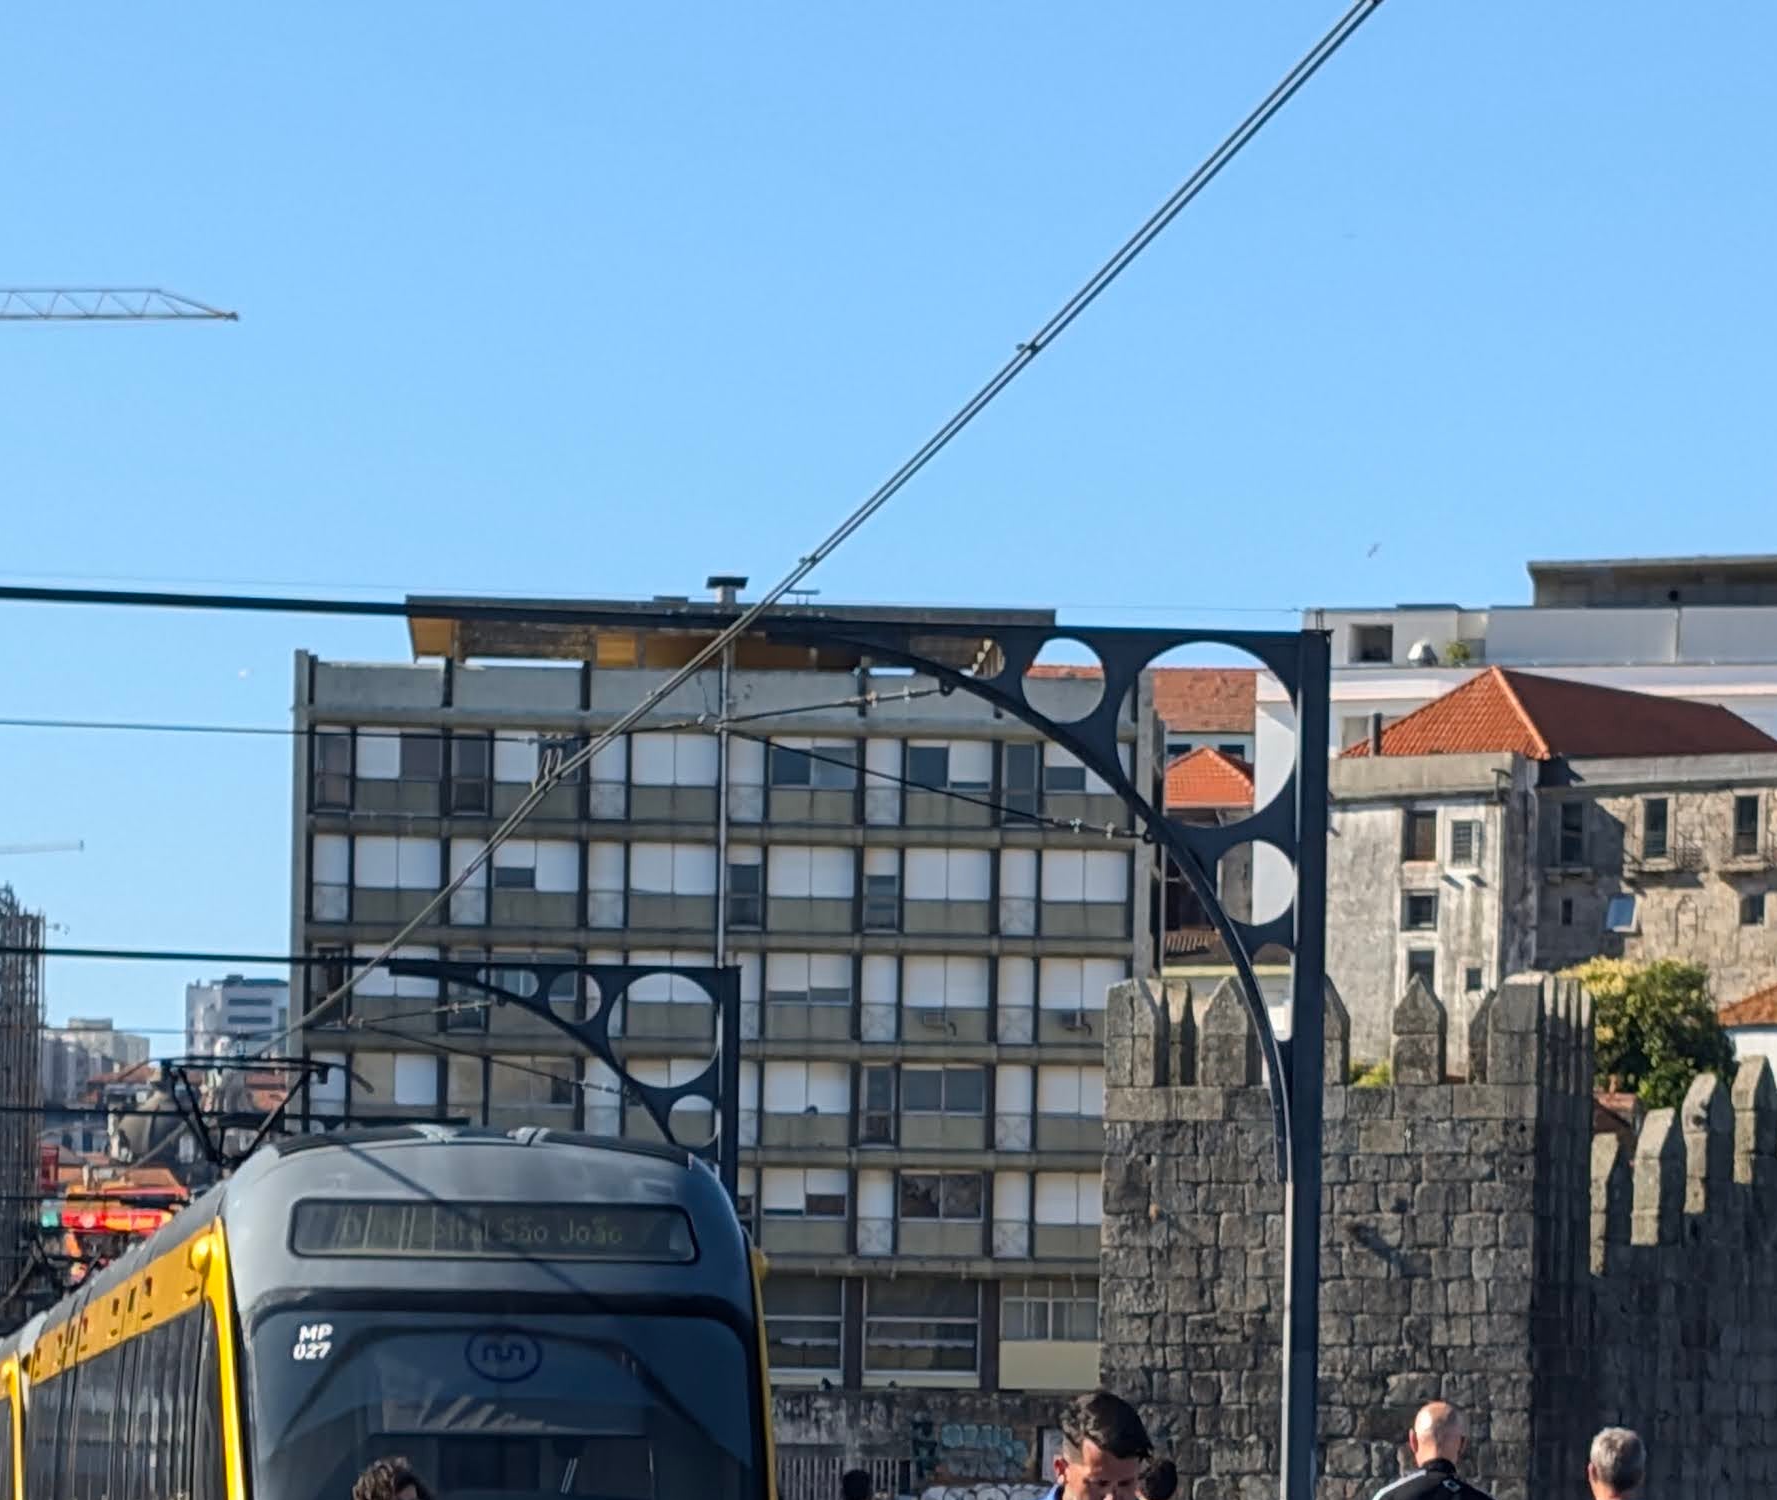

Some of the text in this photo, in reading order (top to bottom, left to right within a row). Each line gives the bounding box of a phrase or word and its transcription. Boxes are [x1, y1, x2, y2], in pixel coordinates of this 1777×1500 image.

[502, 1216, 549, 1243] São
[560, 1216, 623, 1244] João
[299, 1323, 333, 1341] MP
[293, 1341, 331, 1360] 027
